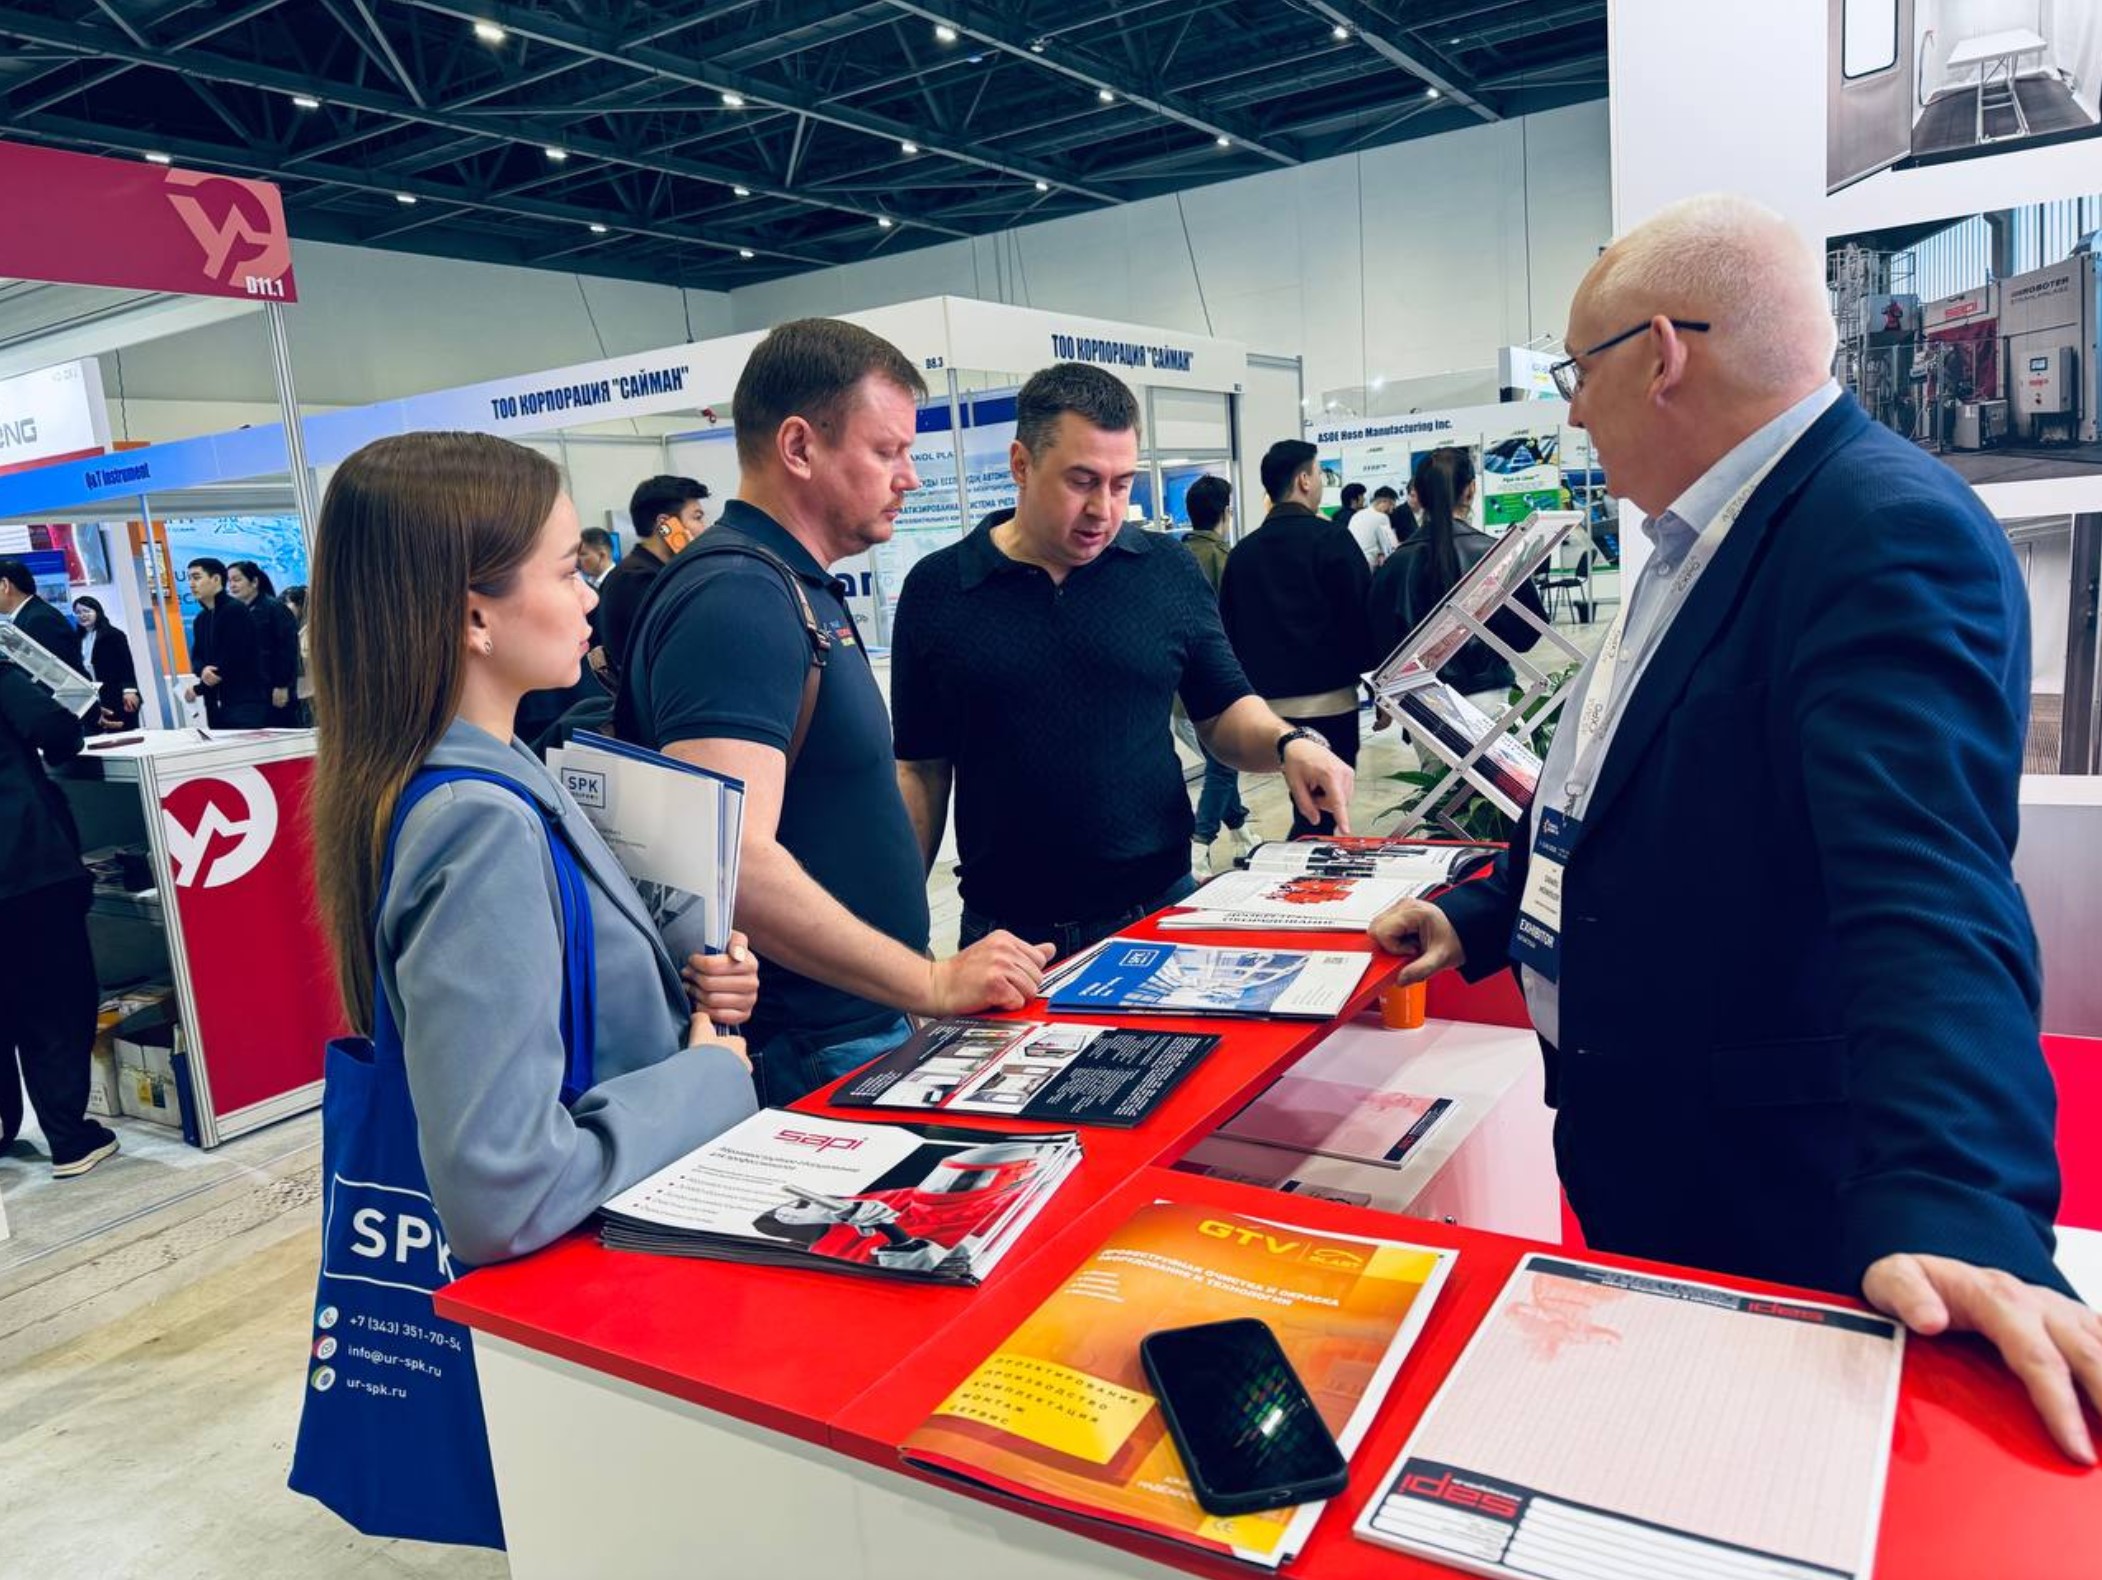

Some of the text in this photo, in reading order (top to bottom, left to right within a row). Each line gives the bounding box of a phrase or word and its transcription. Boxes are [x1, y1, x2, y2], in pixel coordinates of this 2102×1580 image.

[246, 275, 284, 297] D11.1
[1051, 334, 1193, 372] ТОО КОРПОРАЦИЯ "САЙМАН"
[491, 366, 689, 420] ТОО КОРПОРАЦИЯ "САЙМАН"
[1341, 428, 1363, 441] Hose
[1364, 420, 1433, 438] Manufacturing
[1435, 419, 1453, 430] Inc.
[102, 462, 150, 486] Instrument
[568, 775, 598, 793] SPK
[774, 1129, 866, 1153] sapi
[1198, 1219, 1299, 1254] GTV
[1205, 1269, 1264, 1292] ОЧИСТКА
[1206, 1280, 1294, 1307] ТЕХНОЛОГИИ
[350, 1315, 365, 1327] +7
[367, 1318, 400, 1336] (343)
[347, 1344, 442, 1378] info@ur-spk.ru
[346, 1378, 407, 1398] ur-spk.ru
[1398, 1472, 1520, 1520] sapi
